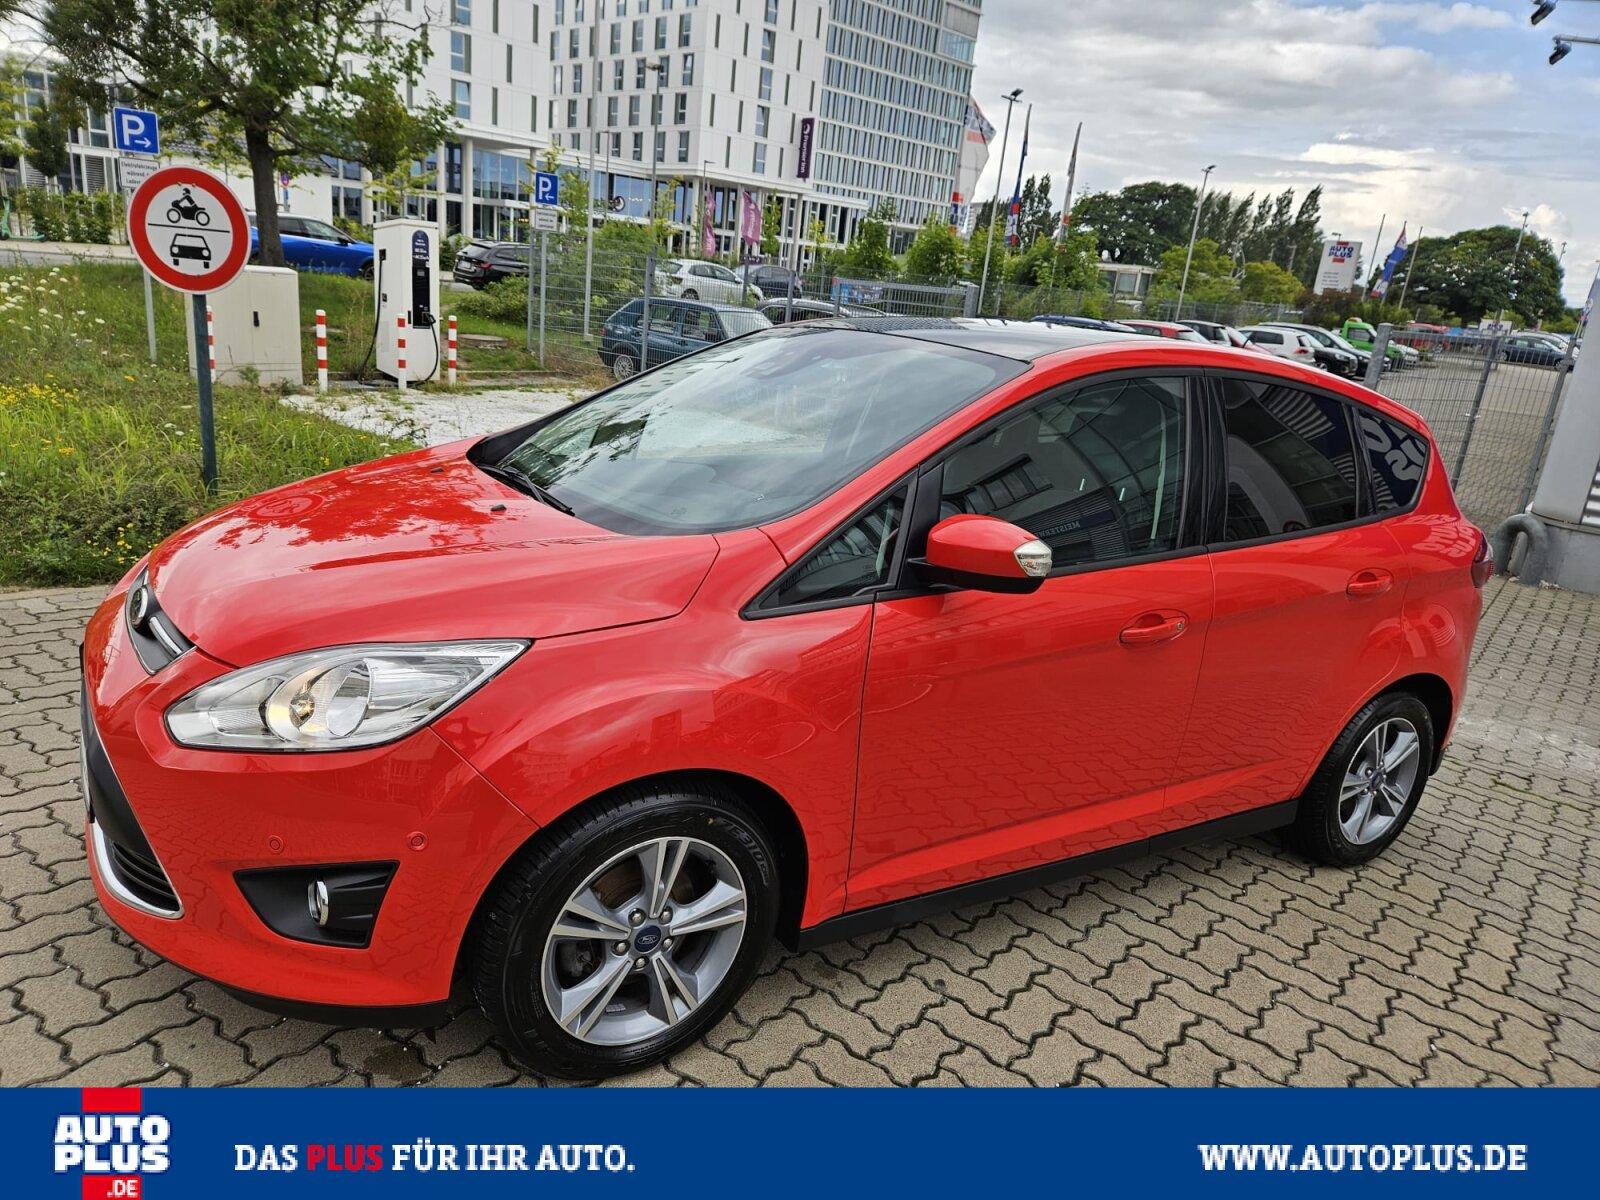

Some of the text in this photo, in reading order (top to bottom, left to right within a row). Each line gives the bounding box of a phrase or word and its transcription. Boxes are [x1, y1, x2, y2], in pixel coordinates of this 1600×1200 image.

[121, 113, 145, 146] P
[538, 176, 552, 200] P
[1330, 245, 1354, 253] AUTO
